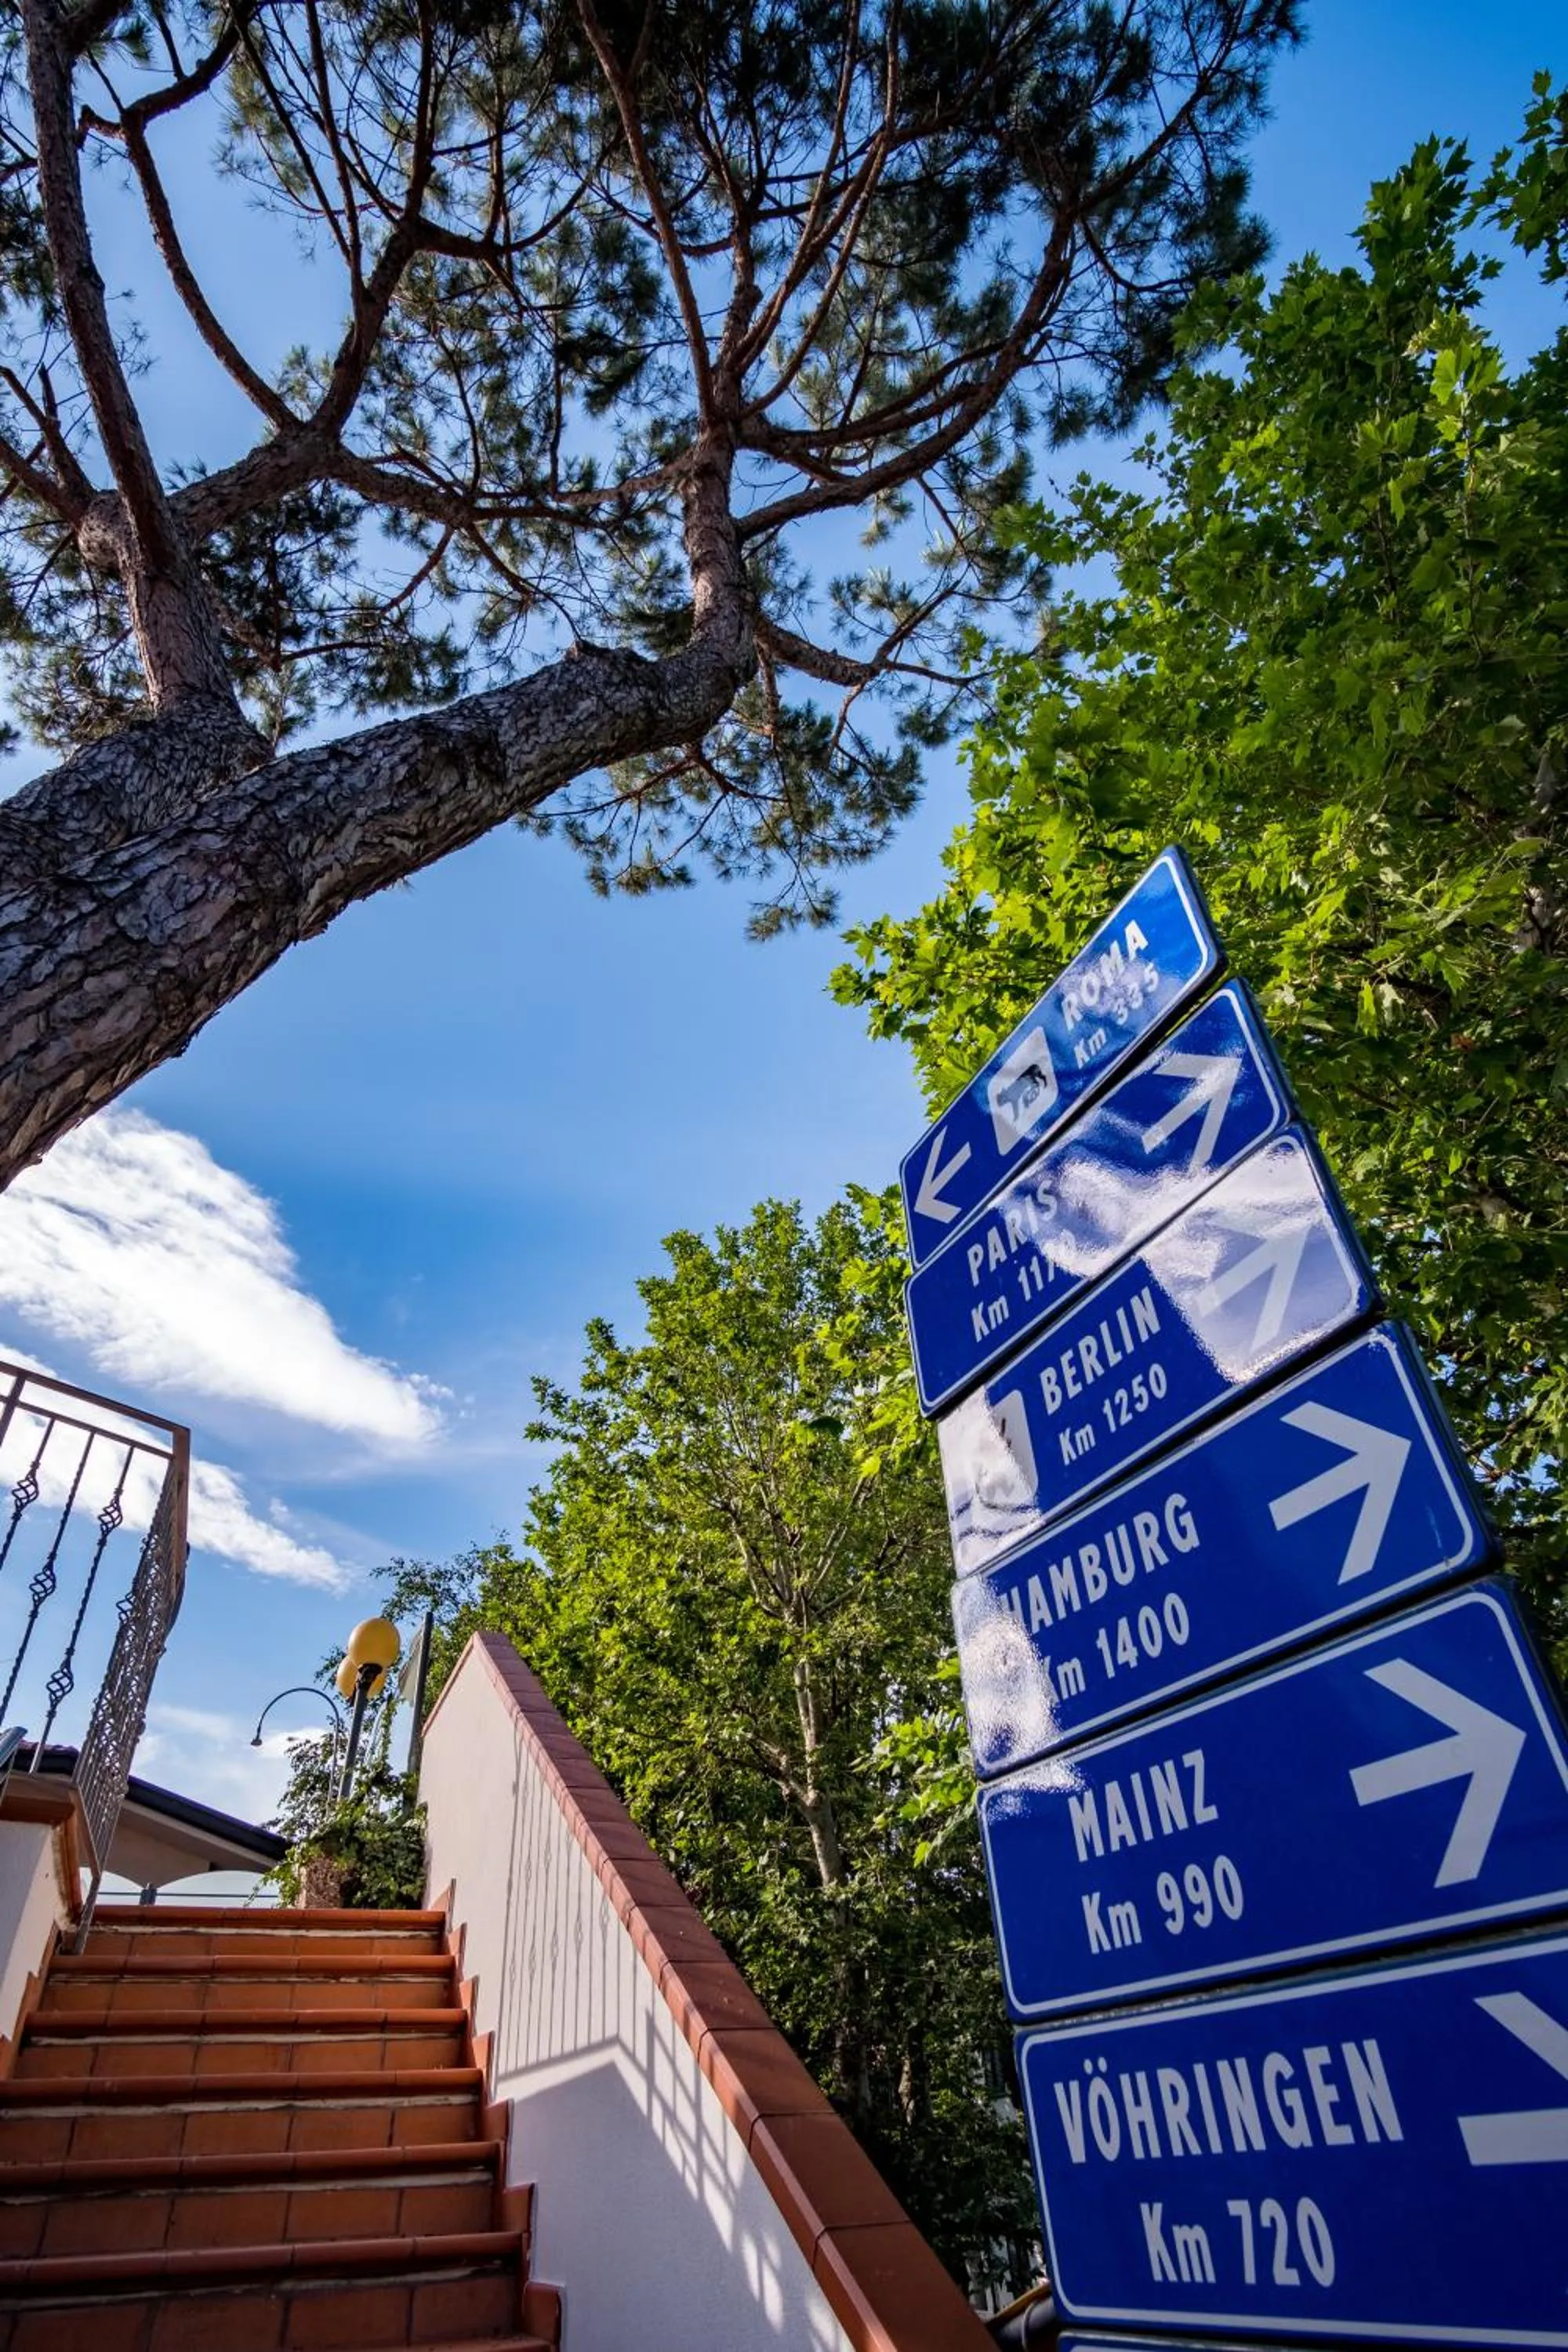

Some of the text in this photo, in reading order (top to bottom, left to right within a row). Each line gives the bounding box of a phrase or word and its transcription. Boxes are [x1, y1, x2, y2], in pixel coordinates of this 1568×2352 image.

[1062, 920, 1149, 1031] ROMA
[1074, 962, 1159, 1069] Km 335
[967, 1180, 1058, 1287] PARIS
[971, 1295, 1010, 1342] Km
[1040, 1286, 1161, 1416] BERLIN
[1059, 1363, 1167, 1466] Km 1250
[1096, 1592, 1190, 1679] 1400
[1067, 1748, 1218, 1863] MAINZ
[1081, 1854, 1244, 1955] Km 990
[1053, 2038, 1404, 2164] VÖHRINGEN
[1140, 2197, 1335, 2288] Km 720
